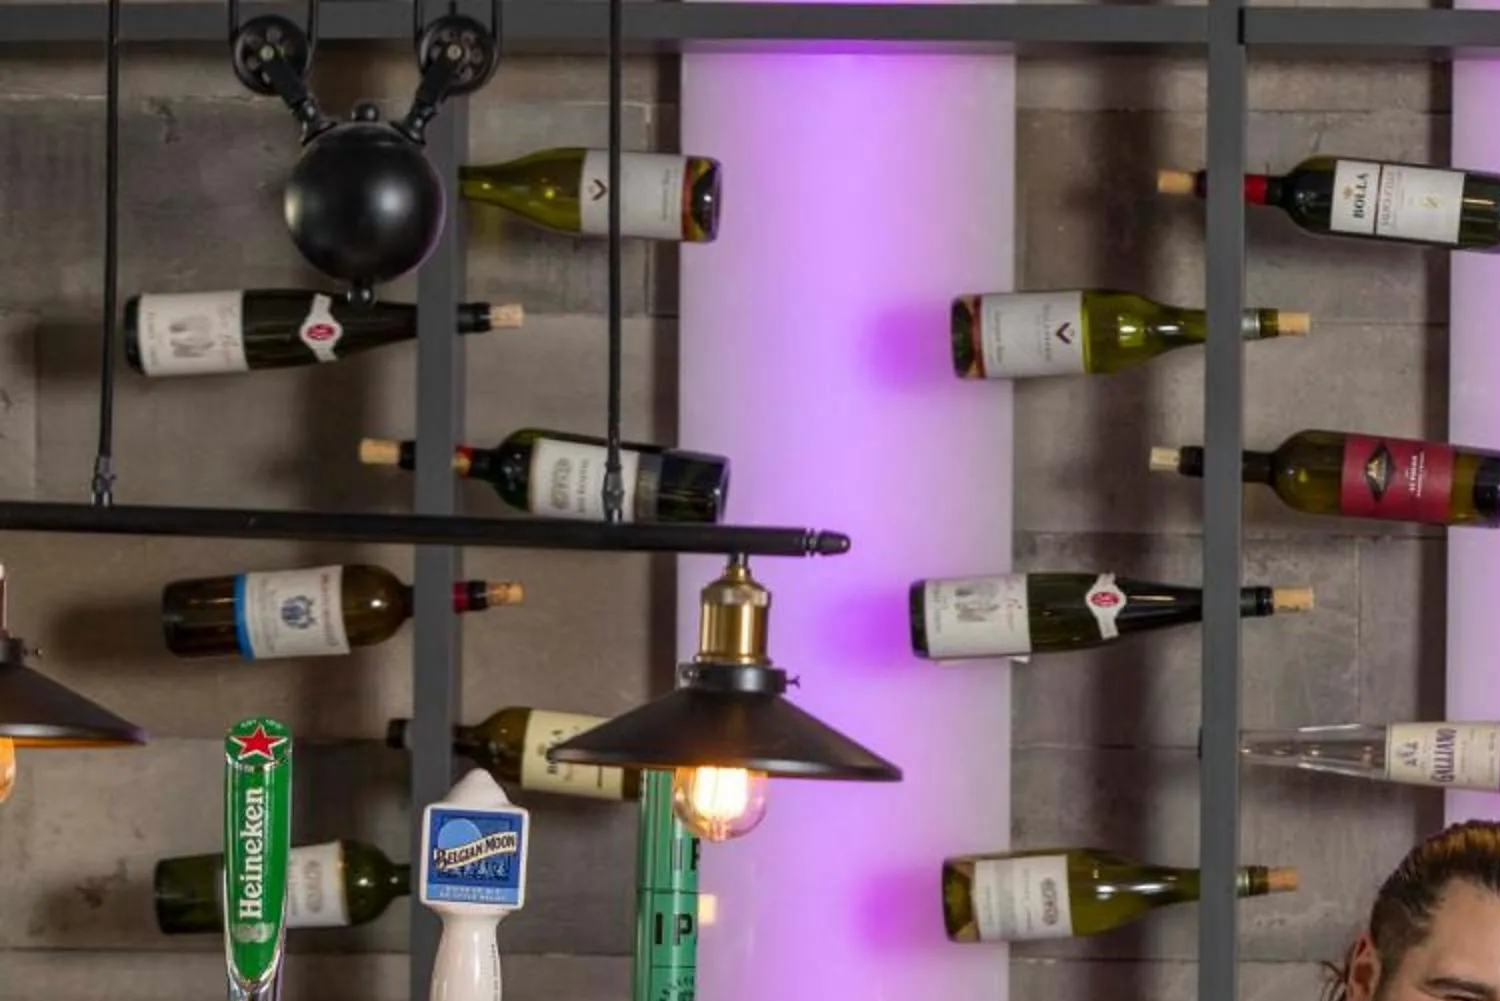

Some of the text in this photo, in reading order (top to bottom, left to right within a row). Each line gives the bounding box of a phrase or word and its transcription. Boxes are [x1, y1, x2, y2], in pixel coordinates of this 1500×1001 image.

[1352, 172, 1370, 219] BOLLA
[1432, 727, 1457, 783] GALLIANO
[239, 786, 265, 919] Heineken
[434, 834, 516, 872] BELGIAN MOON
